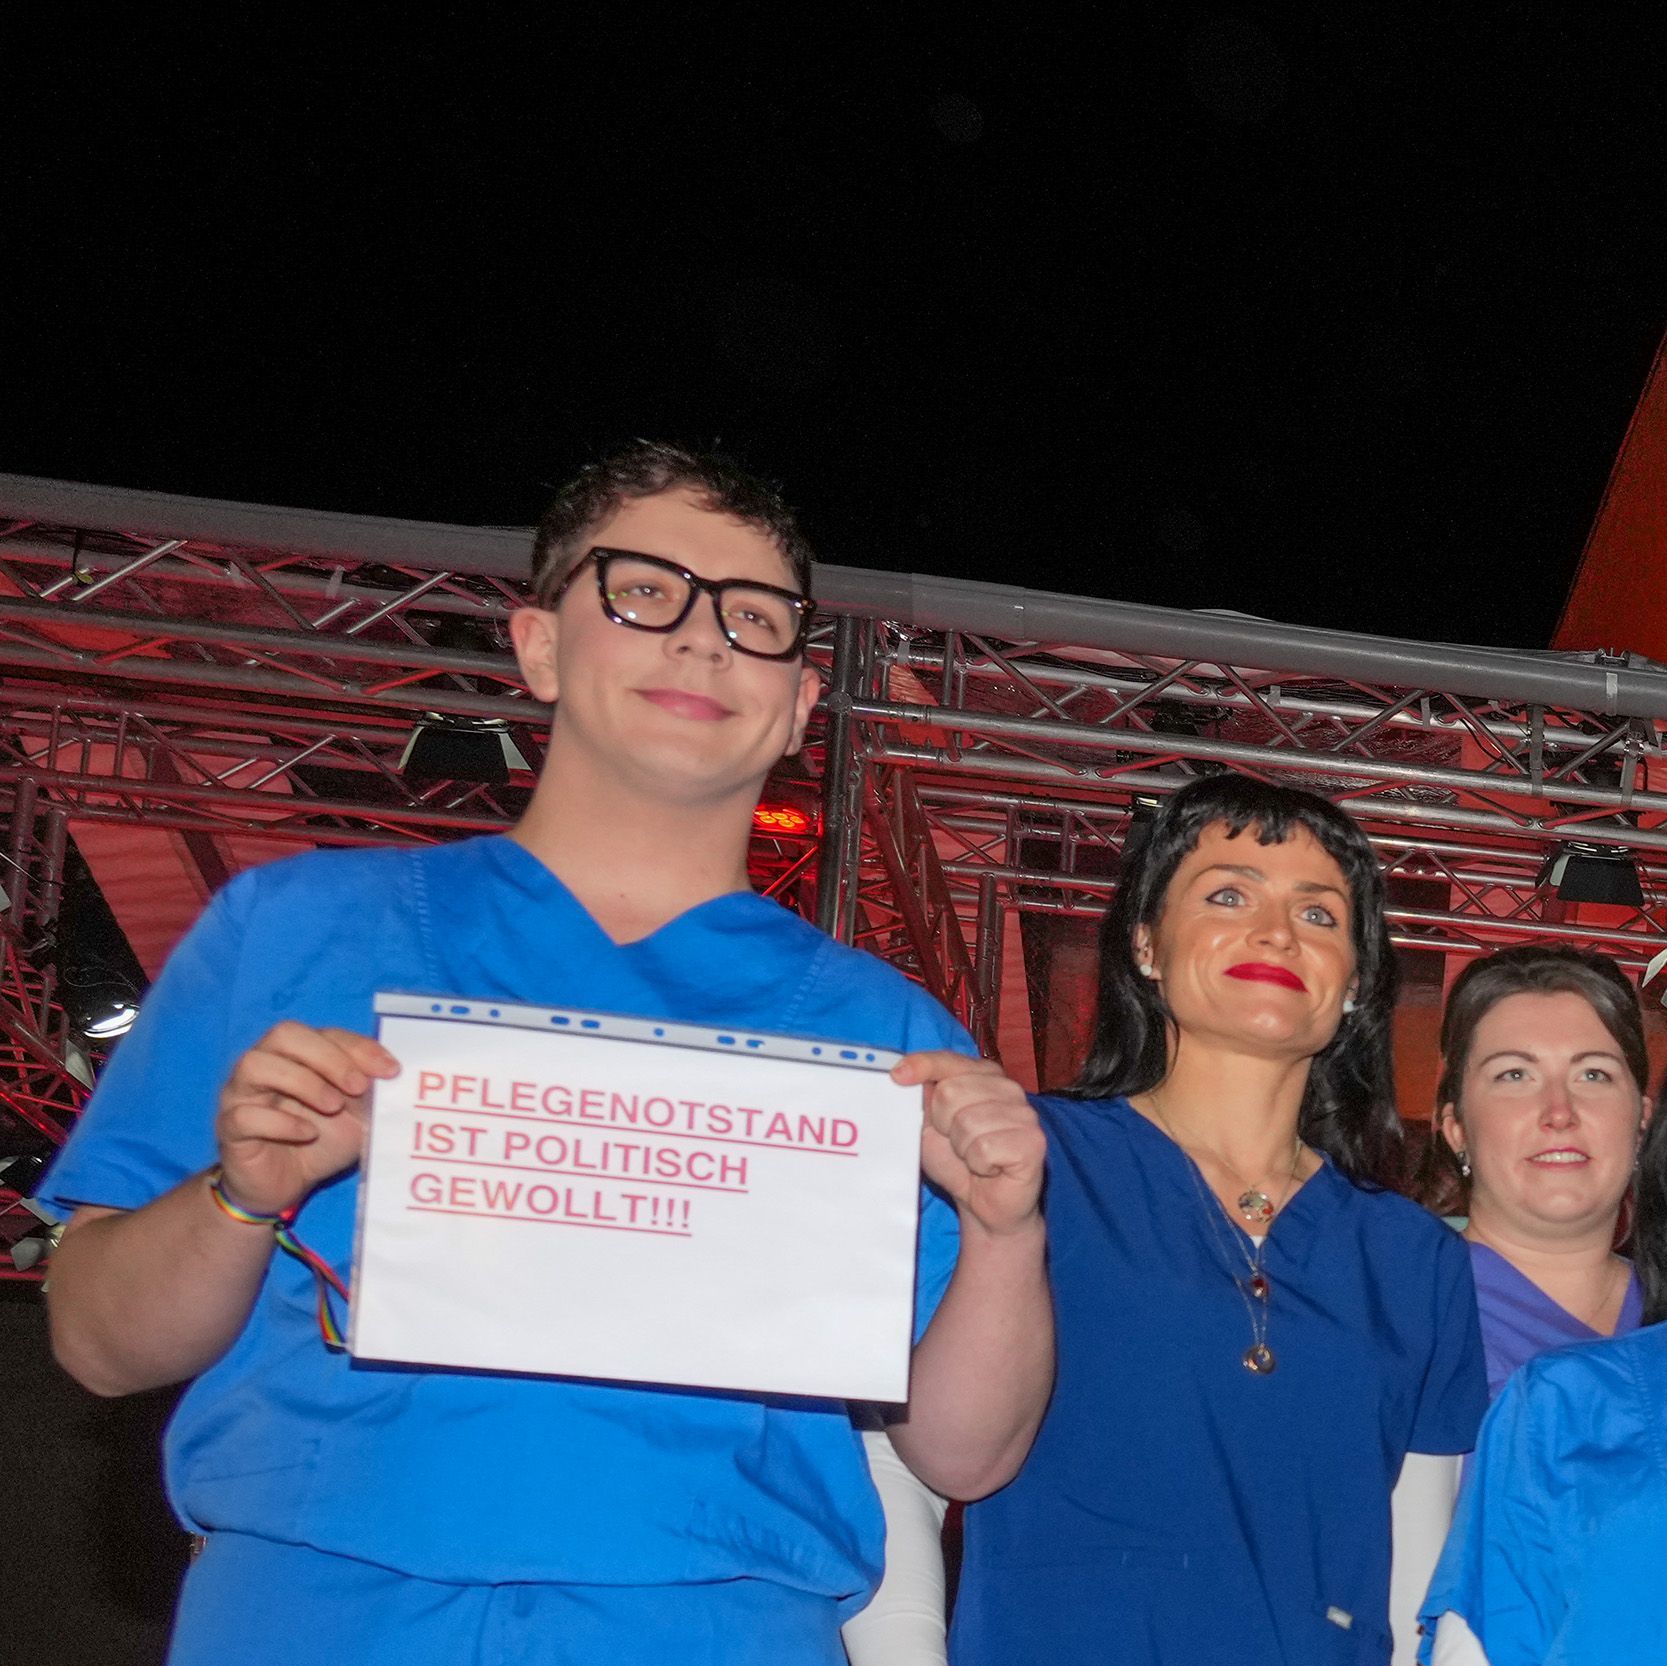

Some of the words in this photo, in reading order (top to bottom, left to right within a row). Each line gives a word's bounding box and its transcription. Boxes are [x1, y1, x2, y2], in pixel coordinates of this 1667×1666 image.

[417, 1071, 859, 1149] PFLEGENOTSTAND
[412, 1121, 487, 1158] IST
[503, 1132, 749, 1187] POLITISCH
[409, 1172, 692, 1229] GEWOLLT!!!
